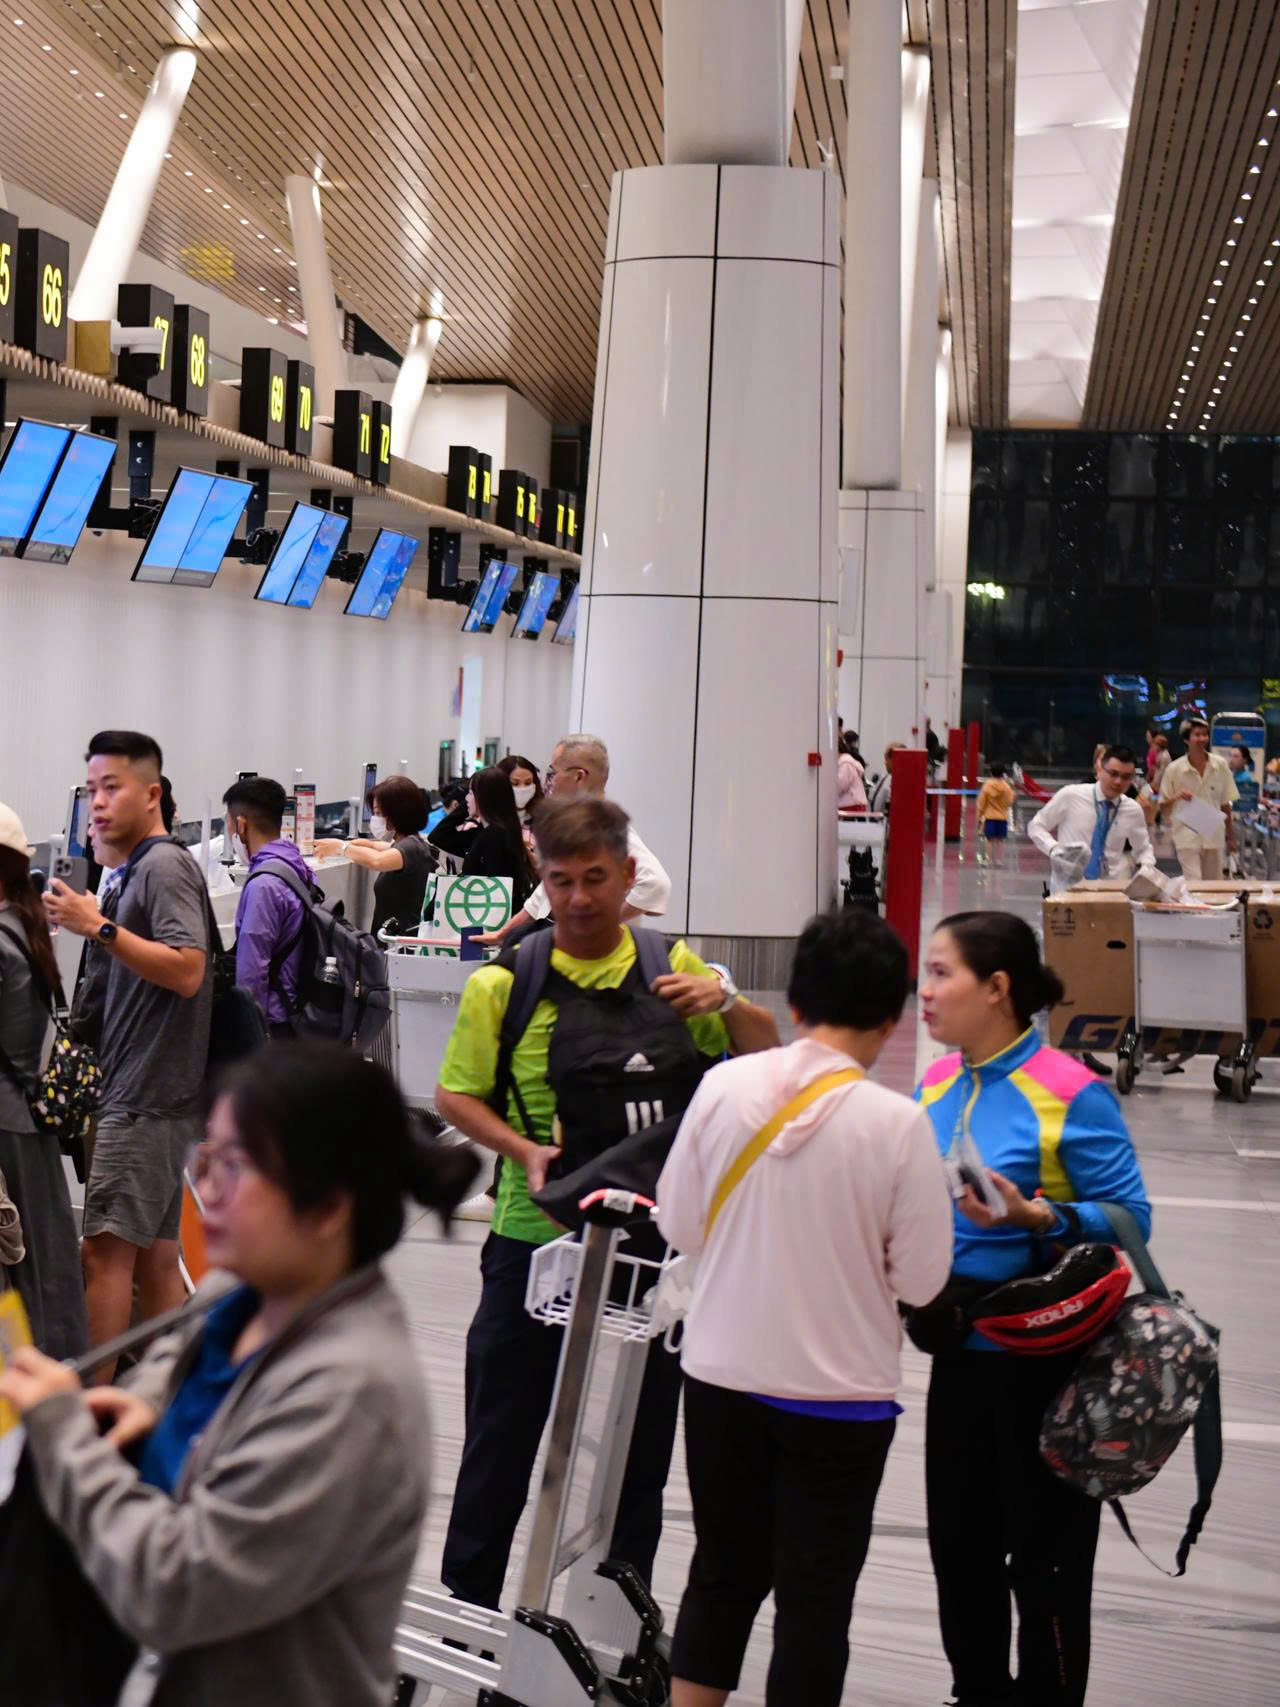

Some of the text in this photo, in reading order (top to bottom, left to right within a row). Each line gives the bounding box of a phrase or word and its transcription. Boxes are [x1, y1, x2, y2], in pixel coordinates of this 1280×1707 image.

[42, 264, 62, 327] 66
[154, 316, 169, 370] 7
[190, 334, 206, 387] 68
[271, 375, 284, 423] 69
[299, 386, 311, 432] 70
[360, 413, 370, 455] 71
[380, 423, 391, 465] 72
